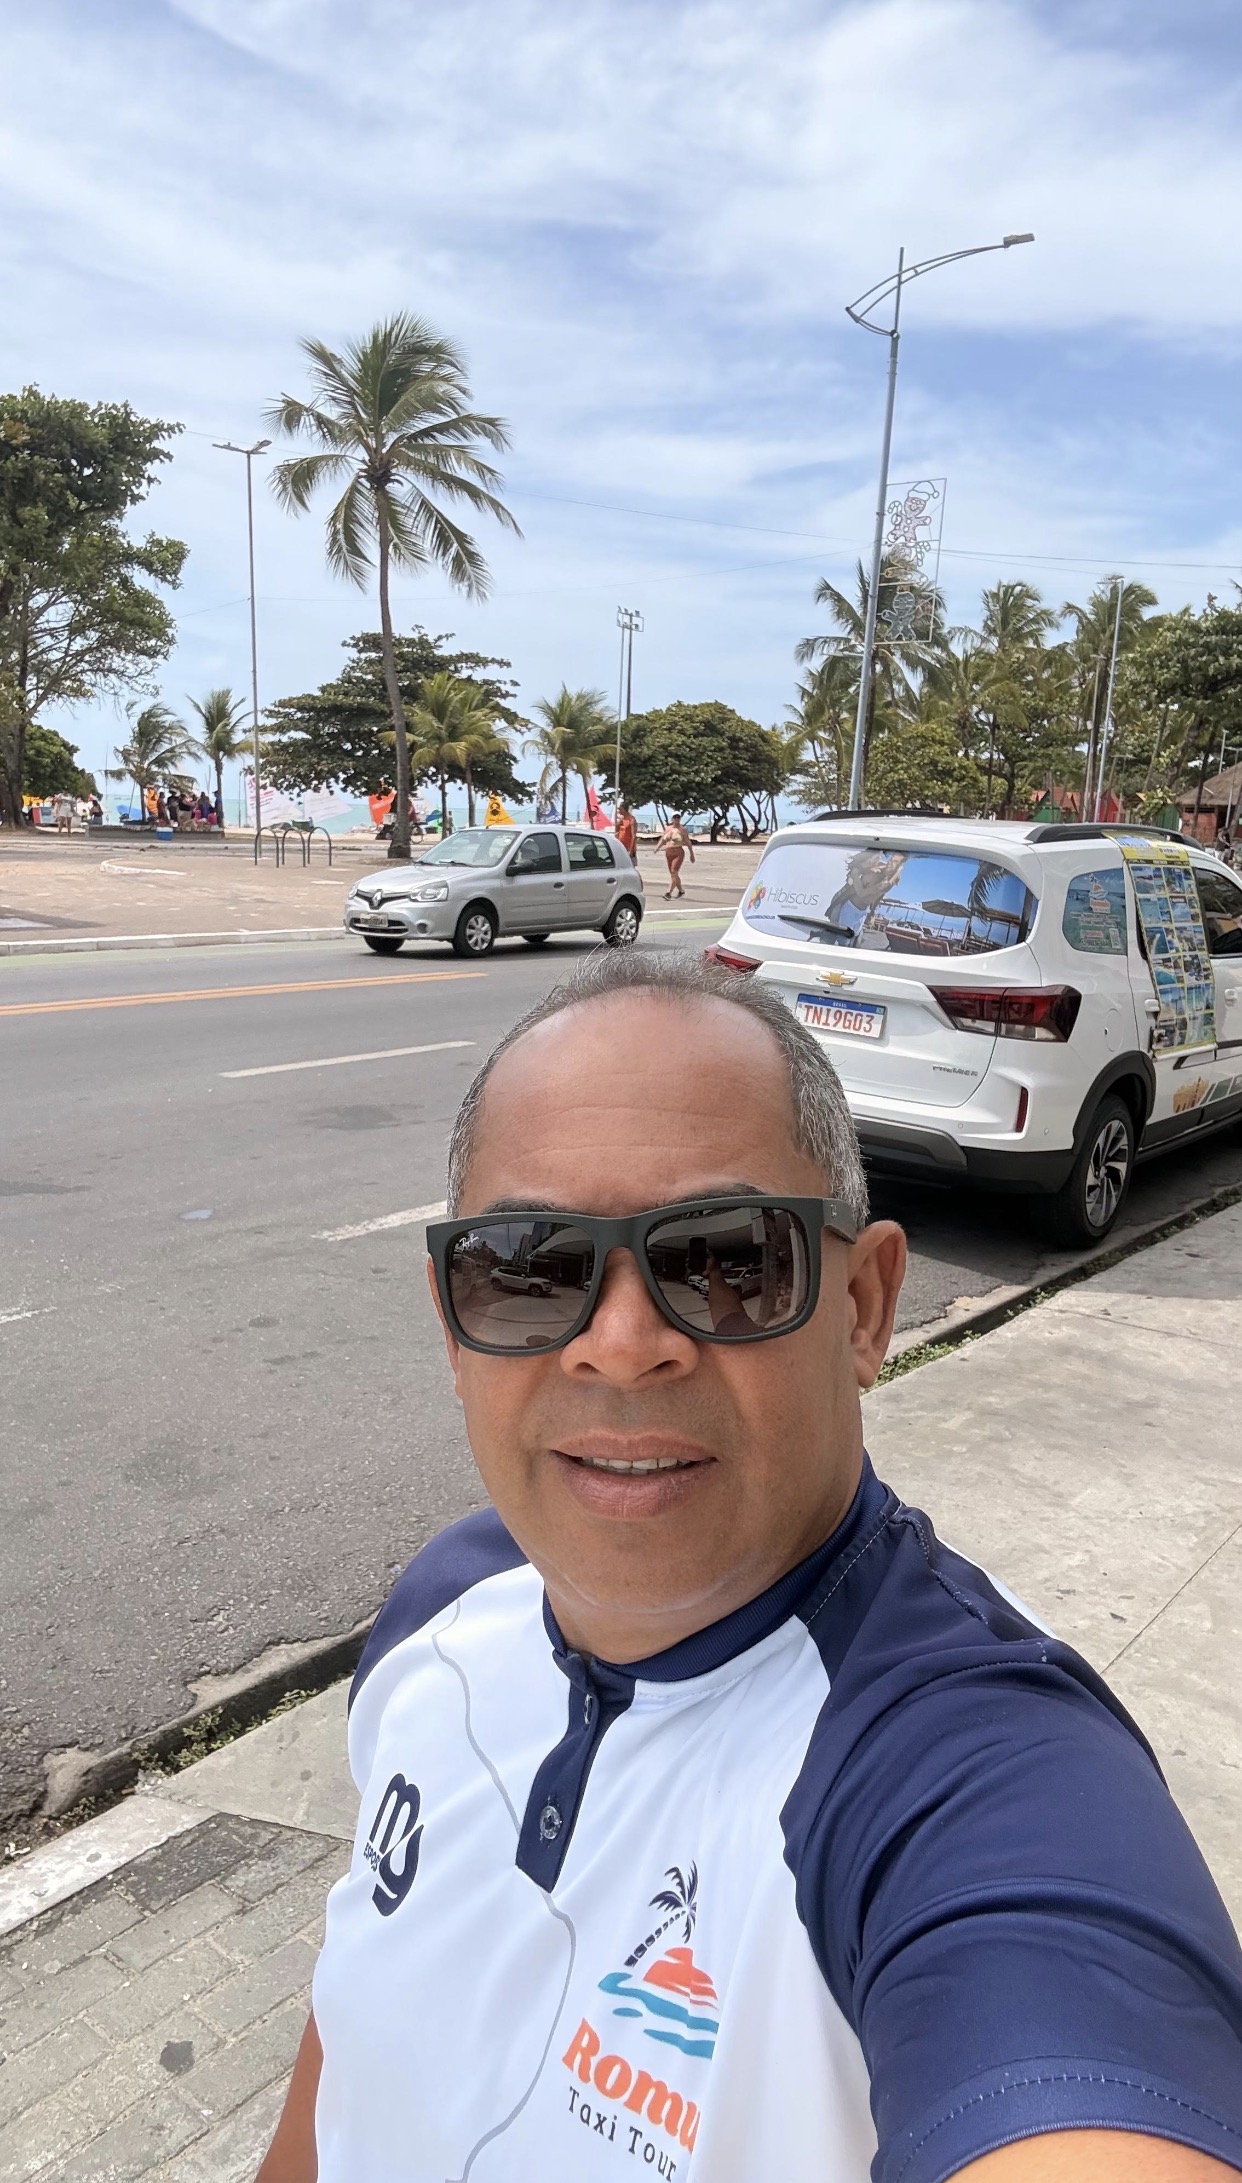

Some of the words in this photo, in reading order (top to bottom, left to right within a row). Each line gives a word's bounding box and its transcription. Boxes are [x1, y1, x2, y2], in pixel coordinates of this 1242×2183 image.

[767, 886, 819, 905] Hibiscus
[804, 1004, 875, 1033] TNI9G03
[568, 2086, 617, 2142] Taxi
[628, 2126, 677, 2182] Tour
